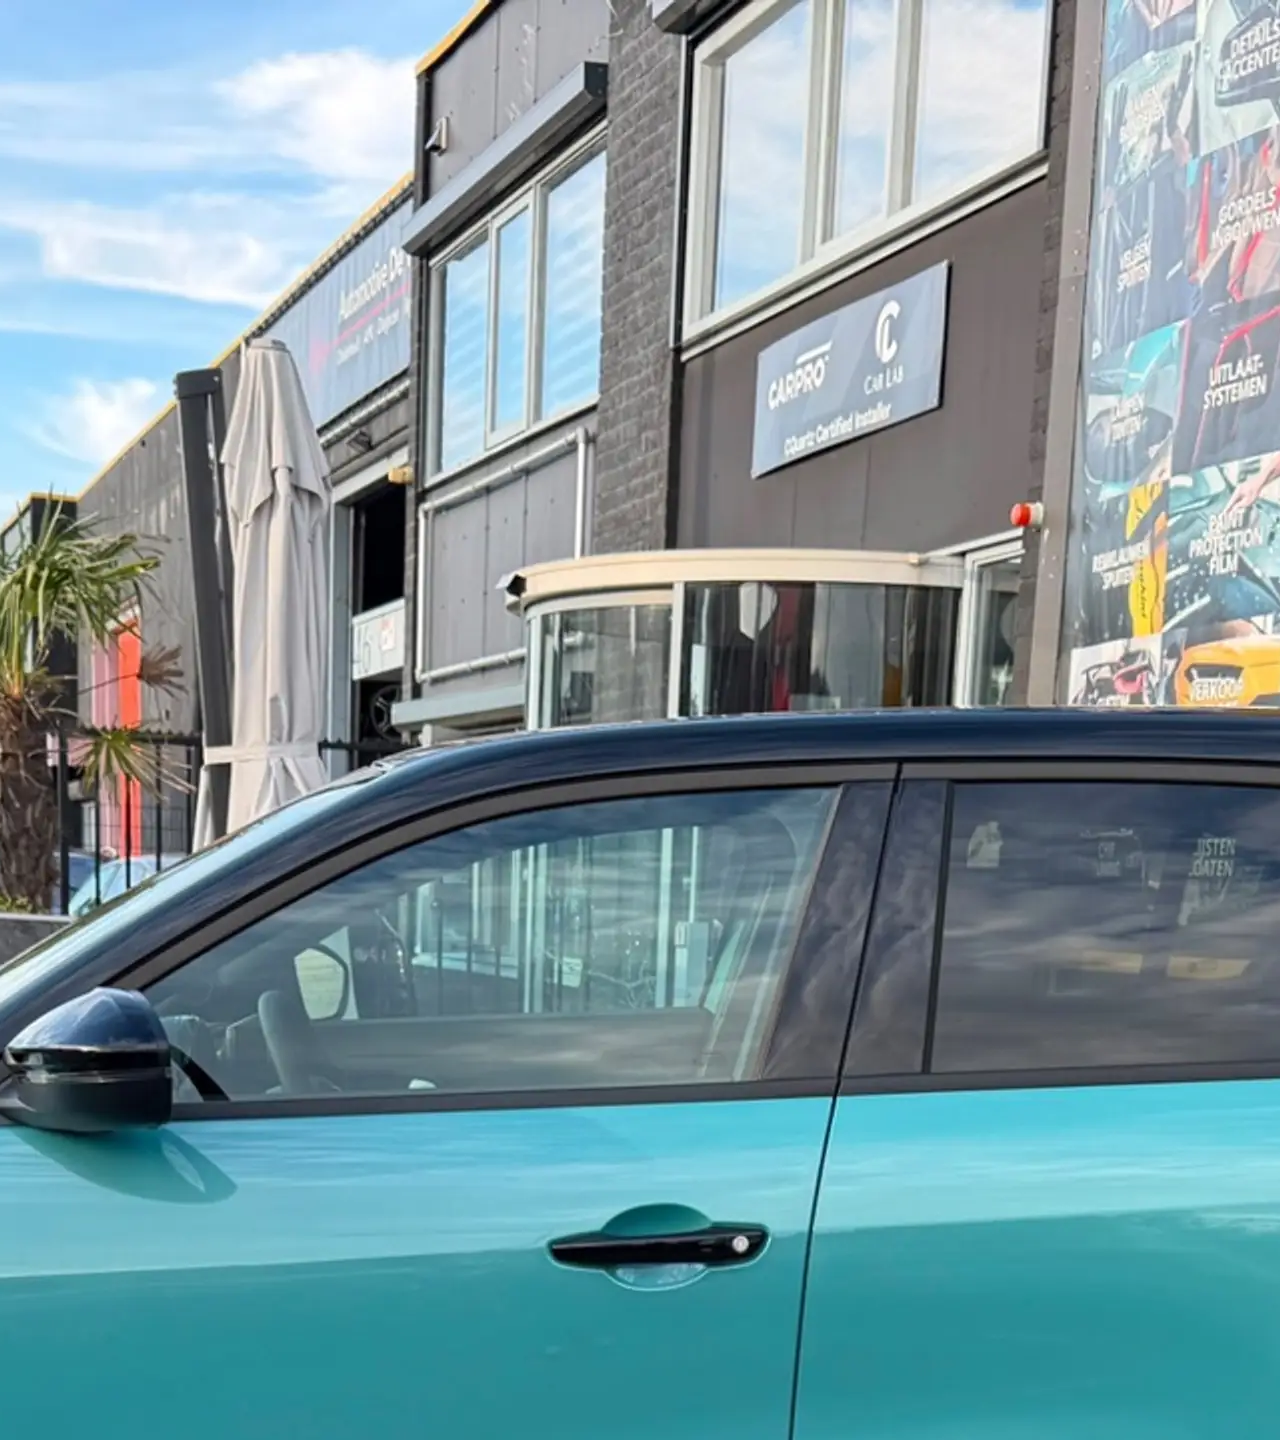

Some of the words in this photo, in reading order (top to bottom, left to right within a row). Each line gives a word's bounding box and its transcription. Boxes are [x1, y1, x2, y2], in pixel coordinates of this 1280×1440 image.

[1219, 186, 1279, 225] GORDELS
[768, 357, 825, 410] CARPRO
[1203, 374, 1267, 410] SYSTEMEN
[816, 411, 854, 444] Certified
[1188, 528, 1263, 559] PROTECTION
[1209, 552, 1239, 576] FILM
